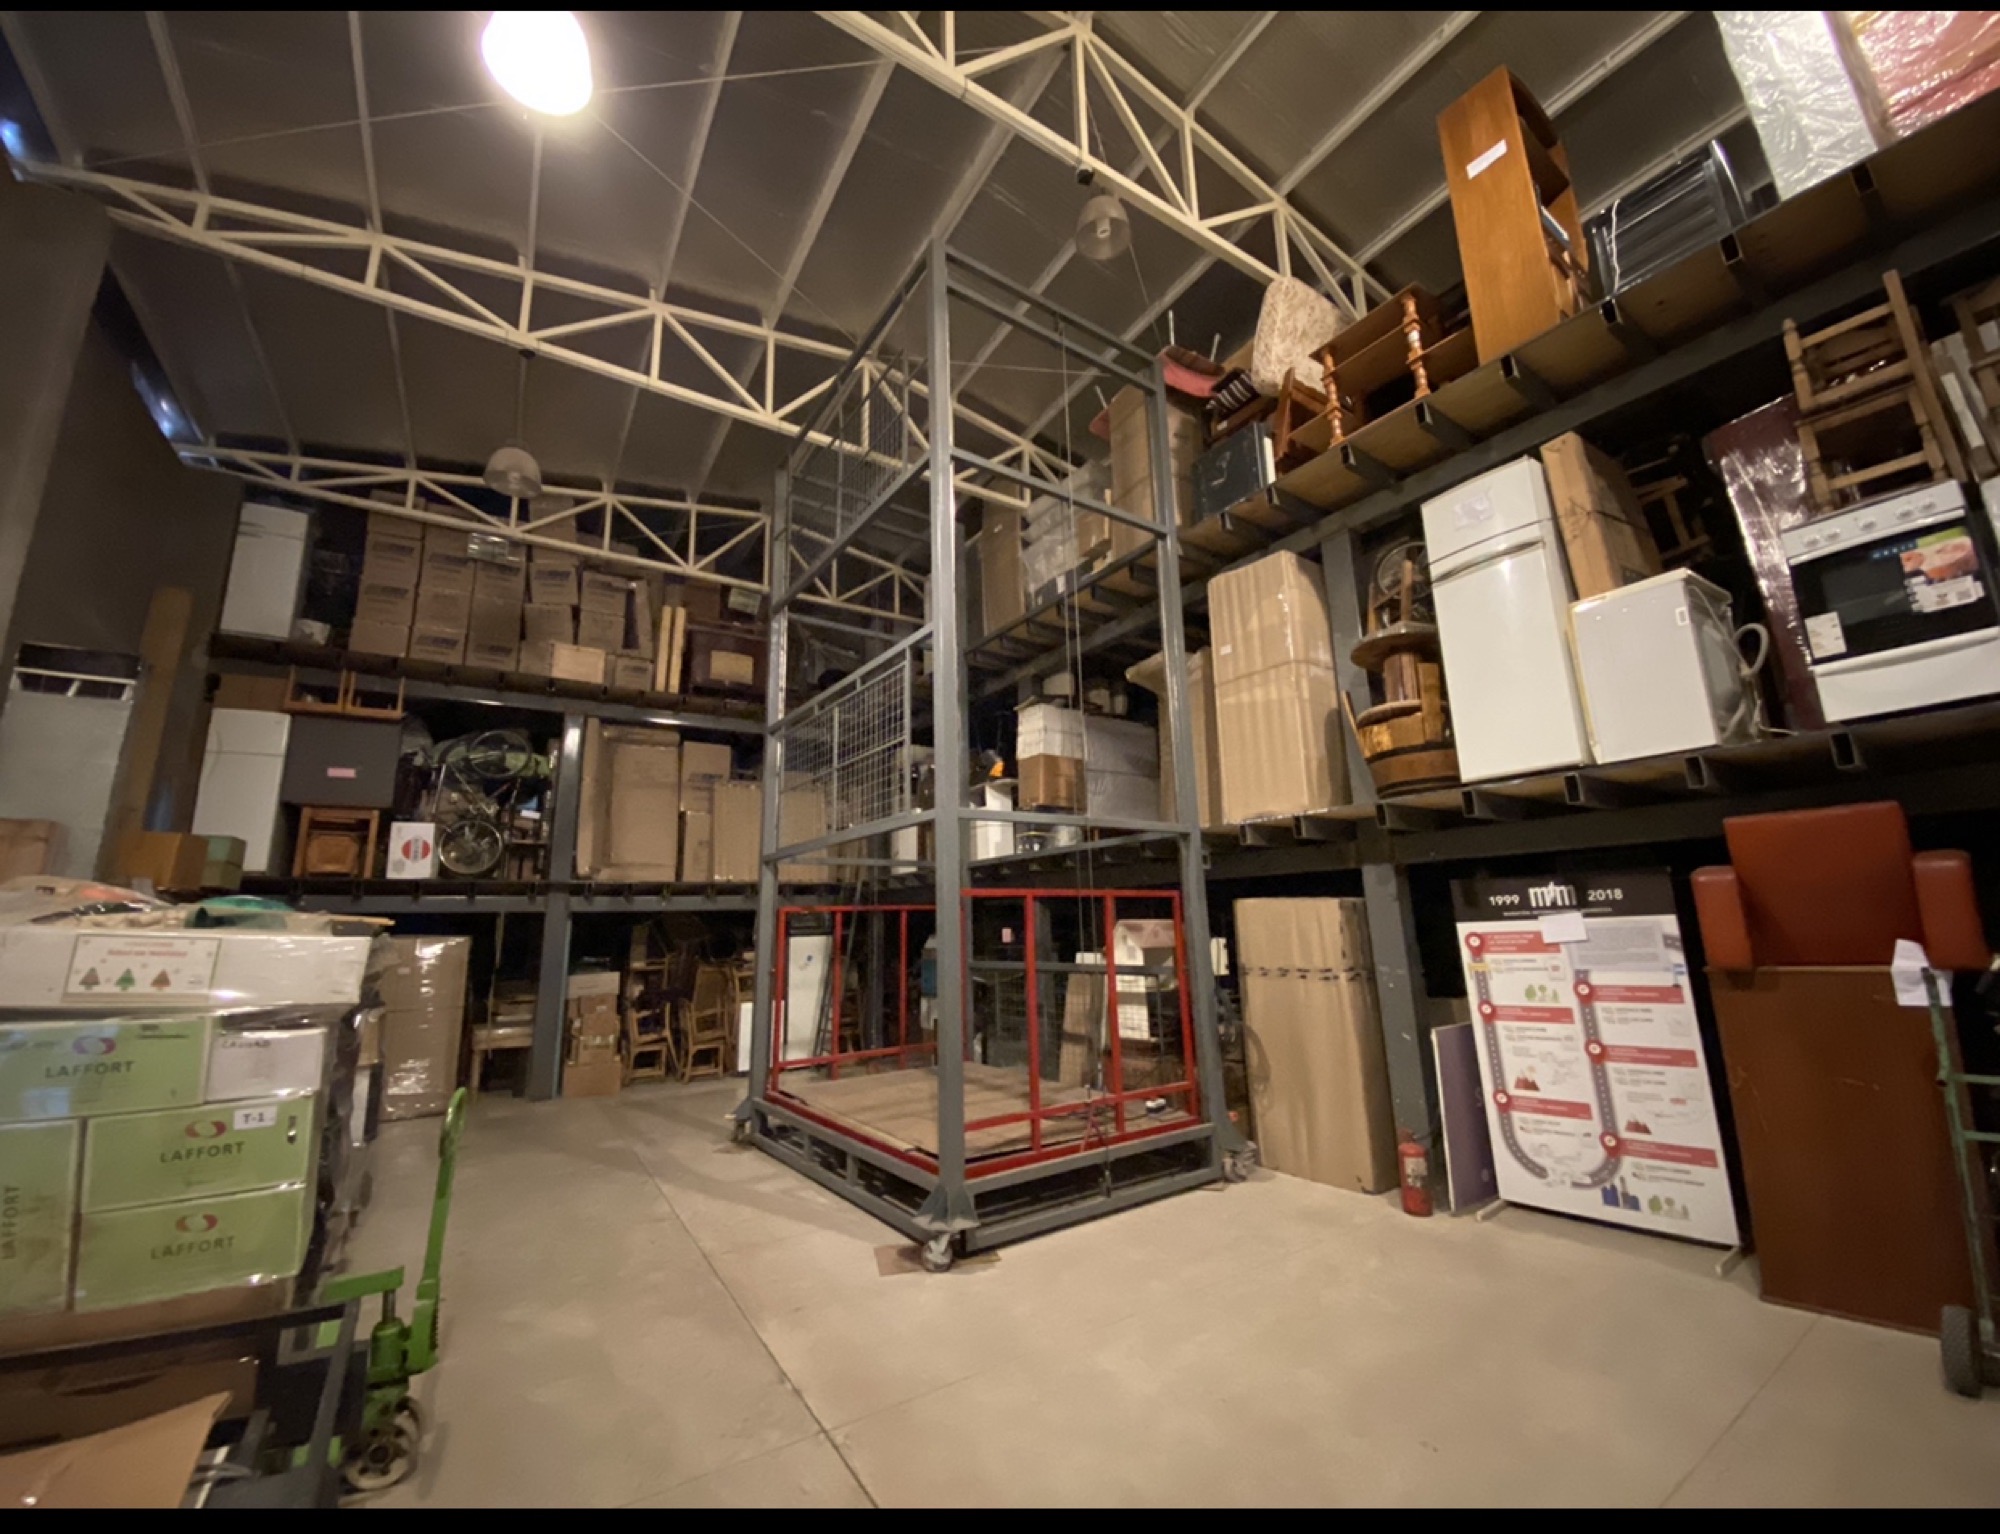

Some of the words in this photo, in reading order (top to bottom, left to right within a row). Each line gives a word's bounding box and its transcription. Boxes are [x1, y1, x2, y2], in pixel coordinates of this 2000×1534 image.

[1488, 894, 1520, 906] 1999
[1586, 887, 1624, 901] 2018
[44, 1060, 136, 1079] LAFFORT
[242, 1111, 265, 1125] T-1
[159, 1140, 246, 1163] LAFFORT
[150, 1235, 236, 1260] LAFFORT
